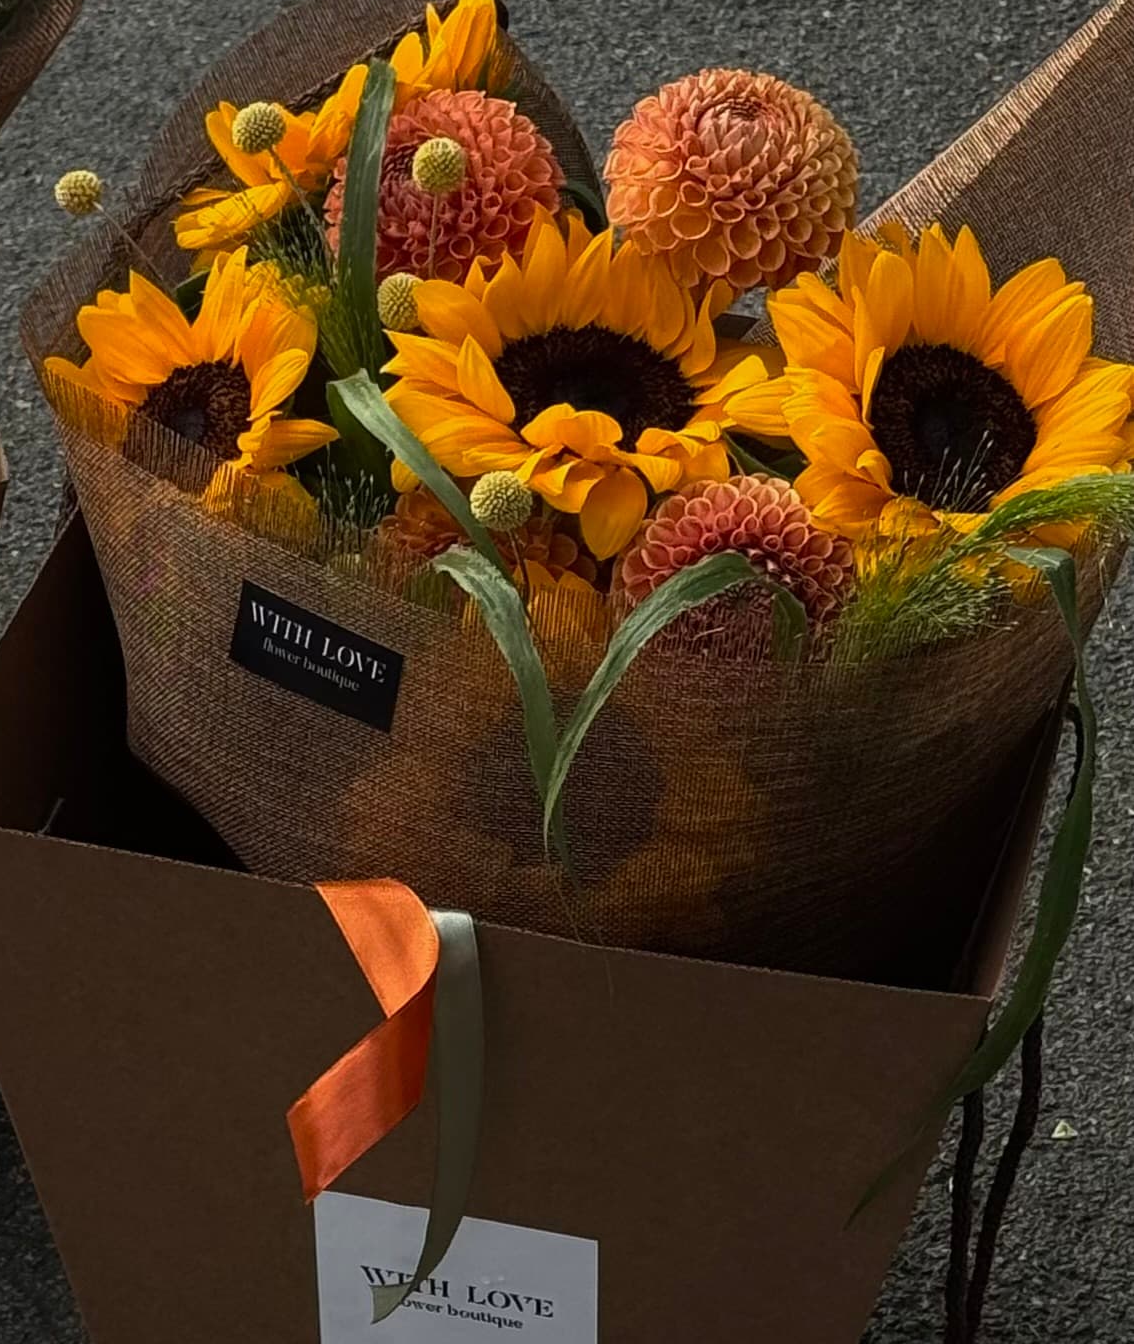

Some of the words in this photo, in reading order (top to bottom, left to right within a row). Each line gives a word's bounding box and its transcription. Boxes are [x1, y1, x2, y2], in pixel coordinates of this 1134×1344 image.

[251, 600, 312, 650] WITH
[321, 637, 387, 684] LOVE
[262, 636, 302, 665] flower
[303, 656, 360, 692] boutique
[395, 1295, 443, 1314] ower
[447, 1303, 524, 1330] boutique
[468, 1285, 554, 1318] LOVE
